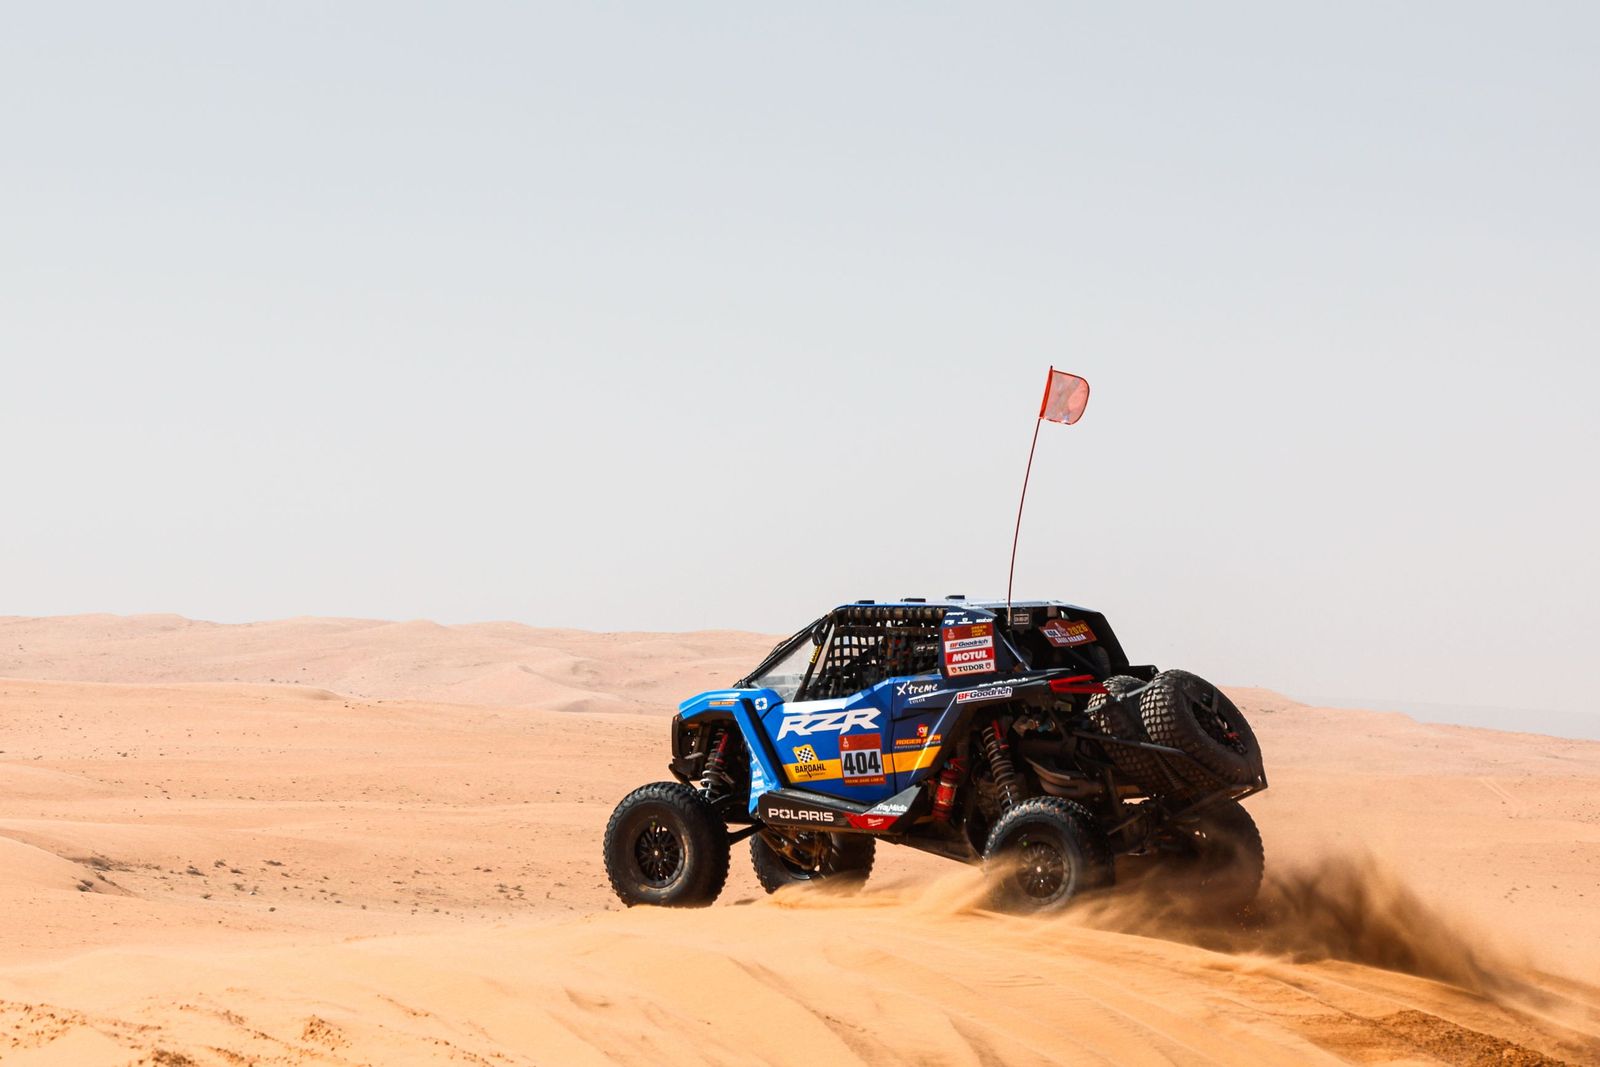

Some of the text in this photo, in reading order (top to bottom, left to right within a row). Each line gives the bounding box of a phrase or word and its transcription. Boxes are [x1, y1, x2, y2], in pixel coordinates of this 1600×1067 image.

[950, 638, 988, 648] BFGoodrich
[952, 650, 988, 662] MOTUL
[958, 663, 984, 672] TUDOR
[957, 685, 1012, 700] BFGoodrich
[777, 708, 882, 741] RZR
[795, 763, 827, 776] BARDAHL
[843, 751, 881, 775] 404
[768, 807, 834, 822] POLARIS
